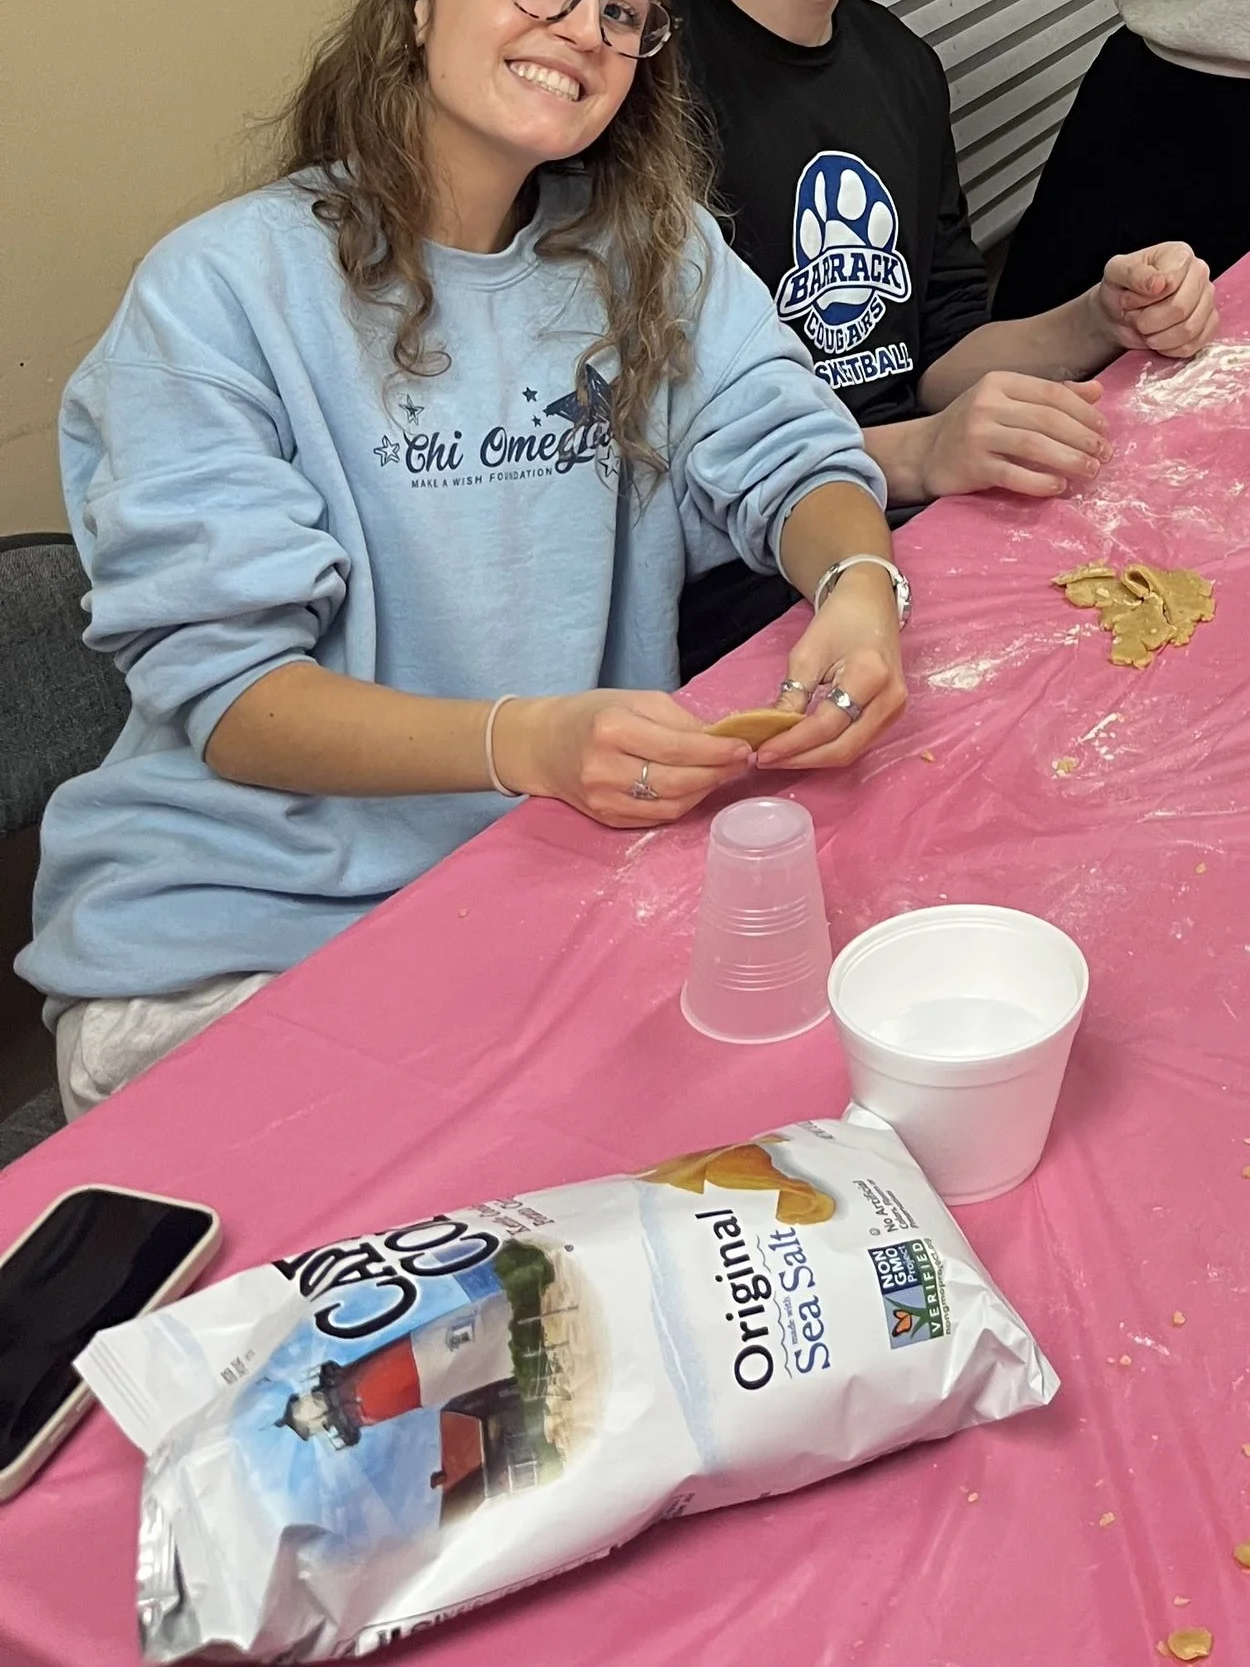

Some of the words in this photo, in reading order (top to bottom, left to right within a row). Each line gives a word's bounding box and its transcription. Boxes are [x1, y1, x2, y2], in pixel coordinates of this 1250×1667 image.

[785, 252, 903, 309] BARRACK
[805, 296, 885, 352] COUGARS
[814, 343, 913, 389] SKETBALL
[403, 430, 463, 474] Chi
[411, 478, 439, 489] MAKE
[442, 478, 448, 487] A
[452, 475, 483, 487] WISH
[489, 467, 554, 484] FOUNDATION
[883, 1217, 899, 1233] No
[767, 1227, 816, 1293] Salt
[872, 1250, 896, 1289] NON
[886, 1247, 908, 1286] GMO
[899, 1245, 919, 1283] Project
[692, 1208, 774, 1391] Original
[913, 1241, 942, 1333] VERIFIED
[794, 1295, 832, 1375] Sea
